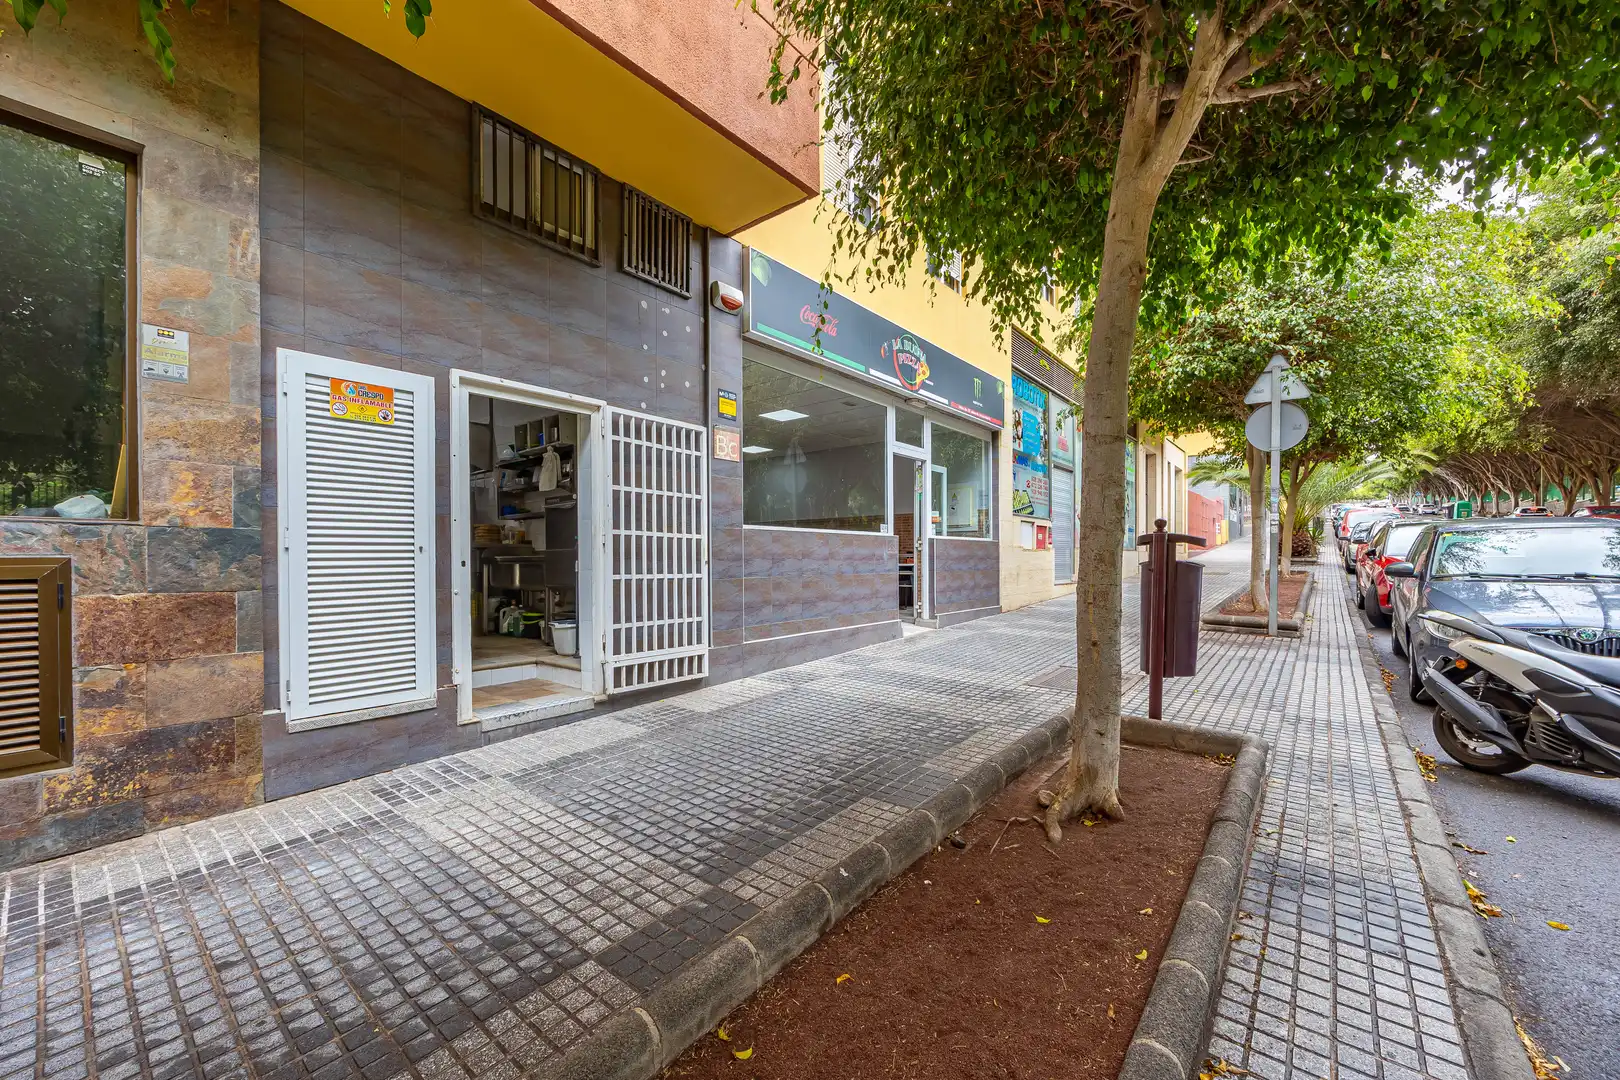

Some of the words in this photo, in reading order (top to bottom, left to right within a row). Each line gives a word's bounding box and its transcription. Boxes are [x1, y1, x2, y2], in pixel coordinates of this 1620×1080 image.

[331, 394, 347, 402] GAS
[349, 397, 393, 408] INFLAMABLE
[358, 390, 384, 400] CRESPO
